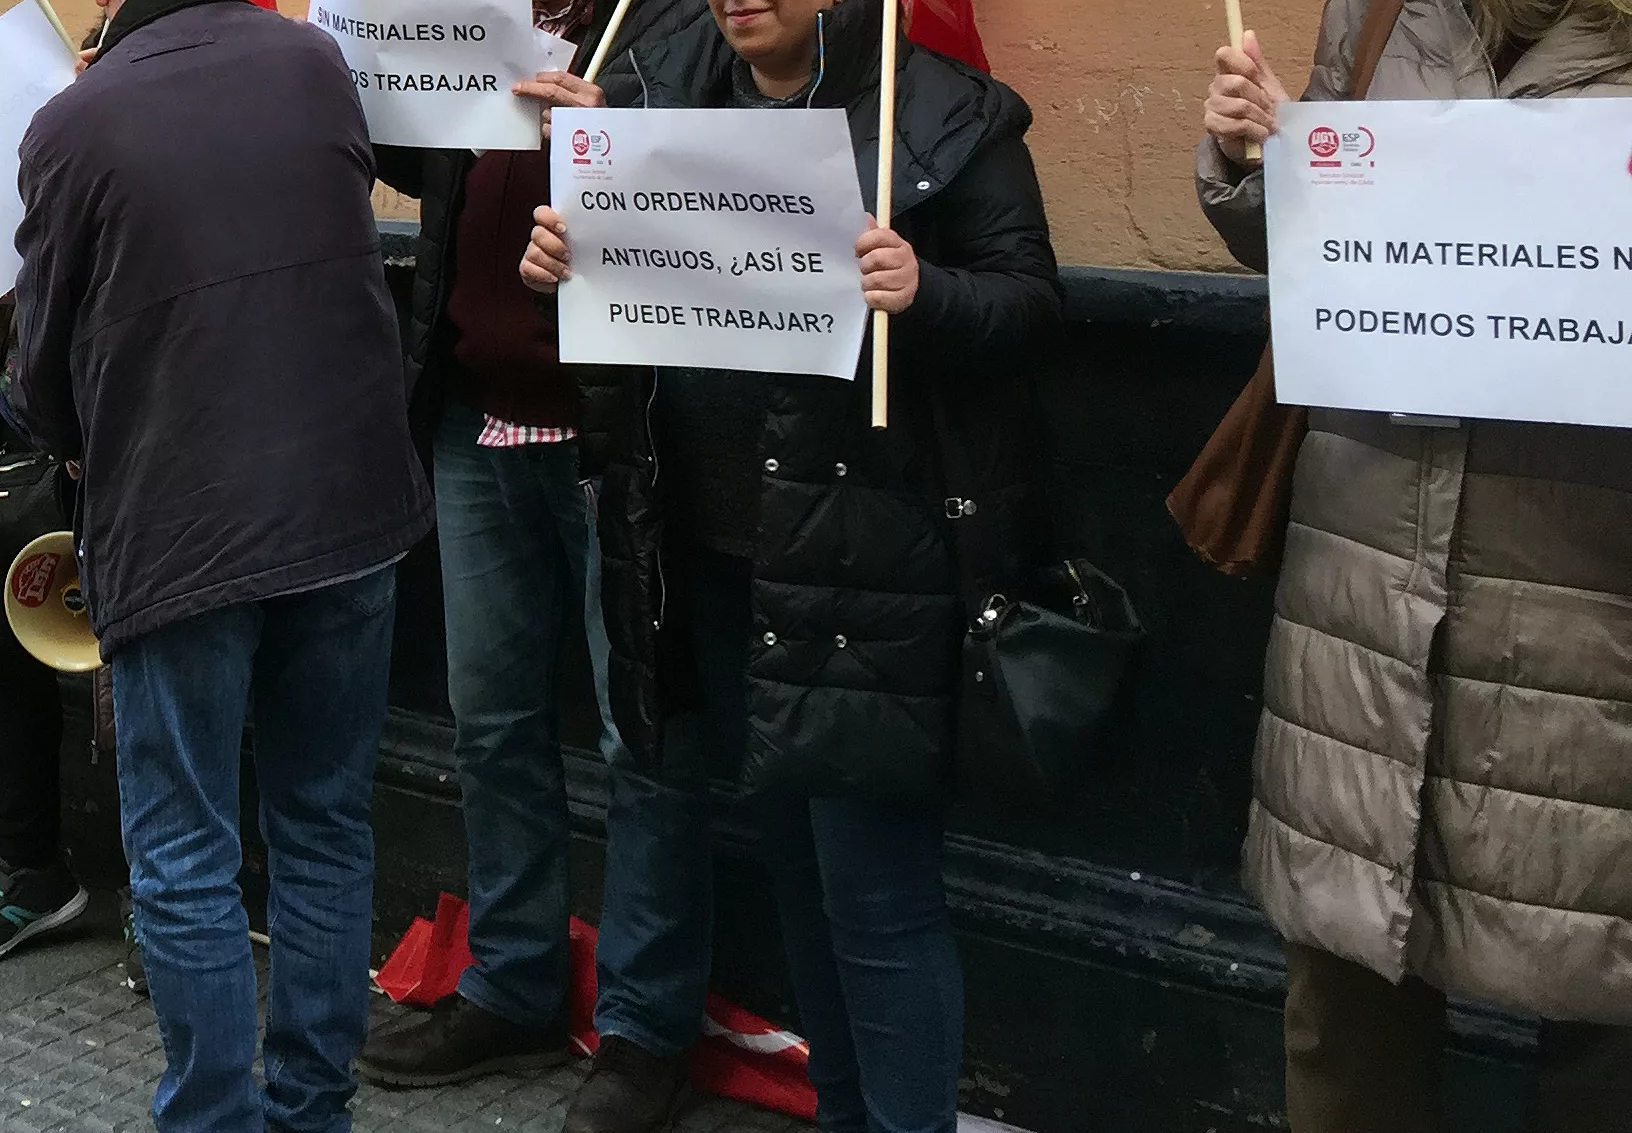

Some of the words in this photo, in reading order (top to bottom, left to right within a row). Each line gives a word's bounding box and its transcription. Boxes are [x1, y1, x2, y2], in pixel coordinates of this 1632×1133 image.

[317, 7, 330, 27] SIN
[332, 14, 445, 41] MATERIALES
[453, 24, 486, 41] NO
[373, 74, 498, 92] TRABAJAR
[1342, 133, 1360, 142] ESP
[580, 190, 627, 211] CON
[633, 191, 816, 216] ORDENADORES
[601, 247, 723, 276] ANTIGUOS,
[729, 247, 785, 277] ¿ASÍ
[791, 252, 824, 274] SE
[1322, 239, 1372, 264] SIN
[1385, 240, 1600, 270] MATERIALES
[1613, 245, 1632, 271] N
[609, 303, 686, 327] PUEDE
[692, 306, 835, 335] TRABAJAR?
[1315, 307, 1475, 338] PODEMOS
[1486, 314, 1632, 345] TRABAJ
